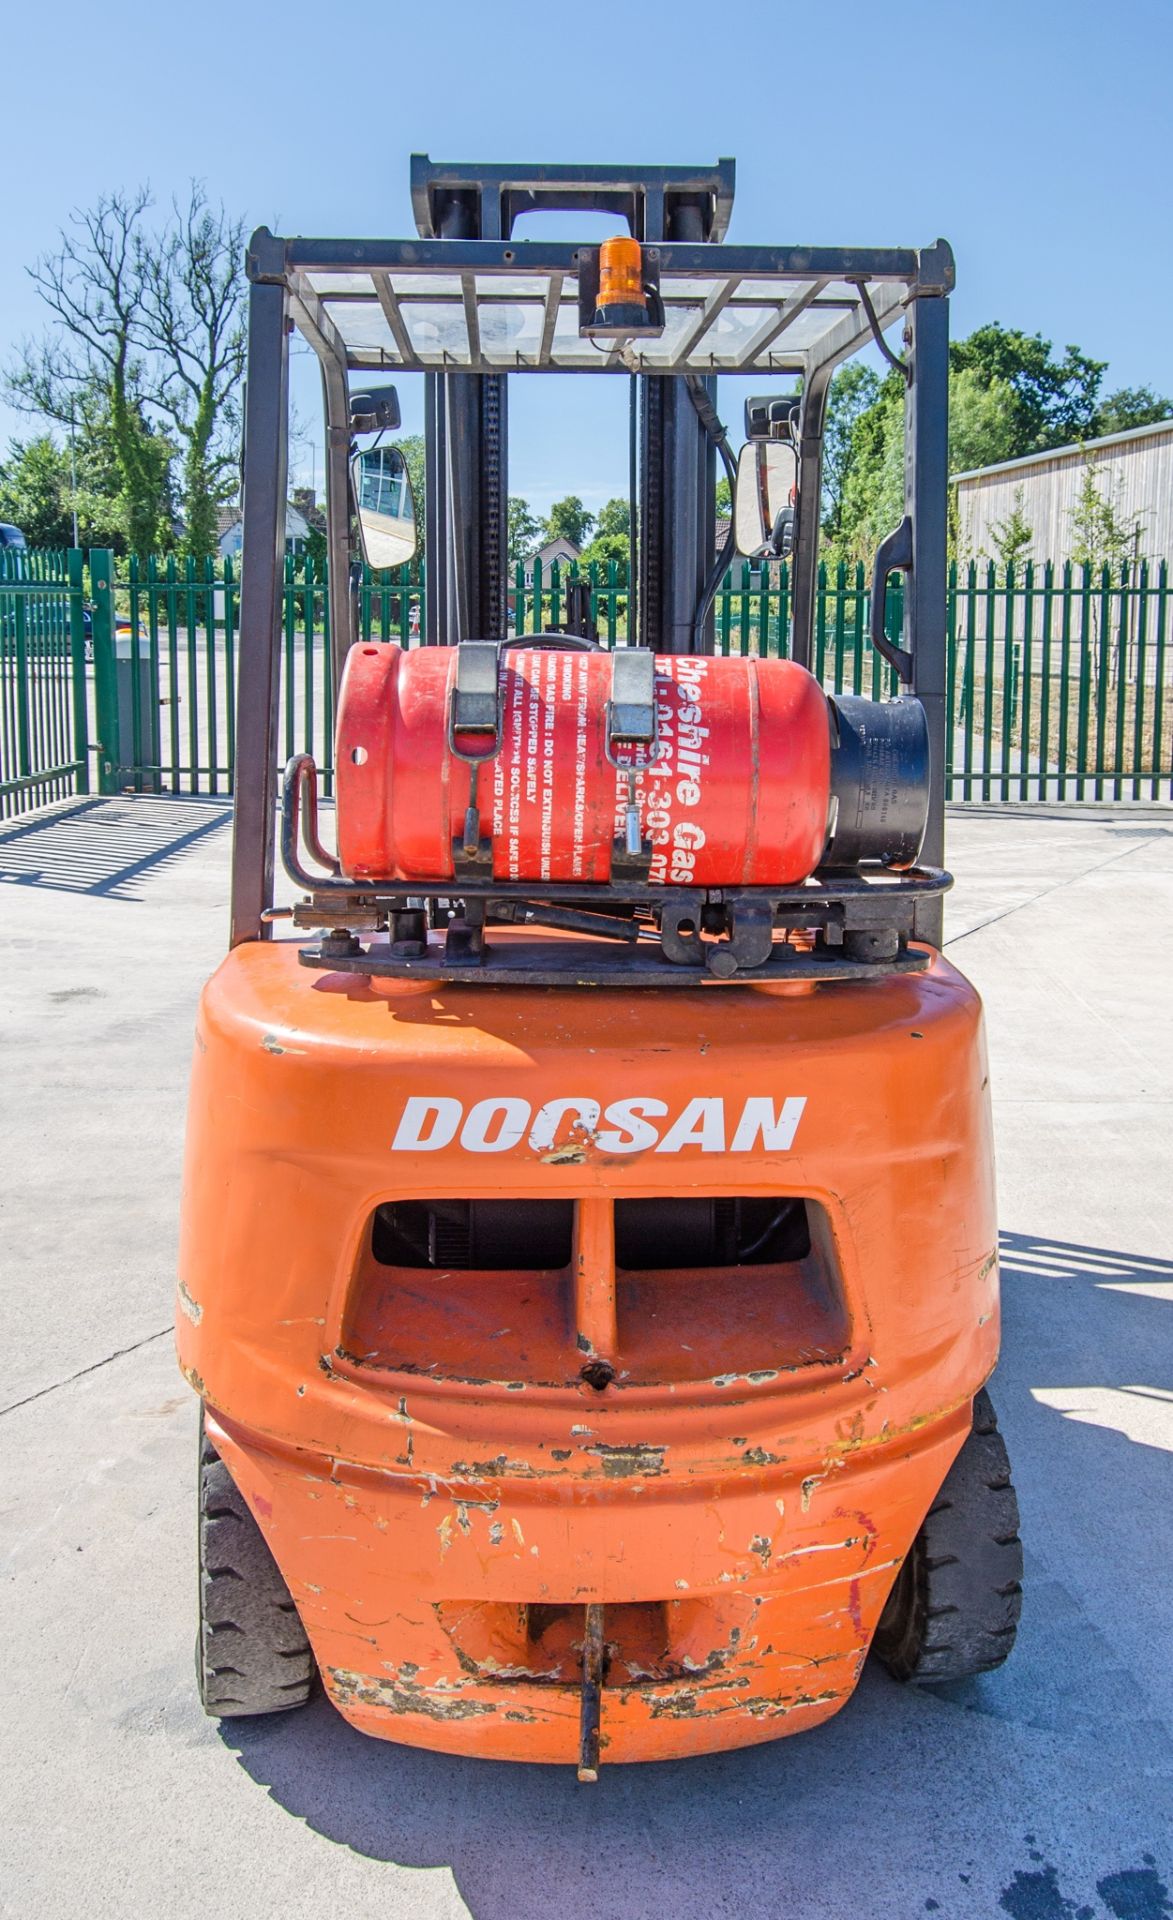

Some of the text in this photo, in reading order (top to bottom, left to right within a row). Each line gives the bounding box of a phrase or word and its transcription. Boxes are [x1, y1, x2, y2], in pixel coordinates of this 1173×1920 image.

[530, 669, 541, 687] CAN
[562, 664, 572, 701] SMOKING
[513, 689, 523, 708] ALL
[530, 687, 539, 700] BE
[546, 684, 556, 702] GAS
[527, 702, 538, 755] STOPPED
[545, 704, 555, 730] FIRE
[544, 740, 554, 757] DO
[526, 757, 537, 804] SAFELY
[543, 760, 554, 786] NOT
[670, 658, 709, 882] Cheshire Gas
[493, 799, 503, 836] PLACE
[509, 825, 519, 836] IF
[541, 788, 553, 855] EXTINGUISH
[509, 838, 519, 862] SAFE
[391, 1096, 808, 1153] DOOSAN
